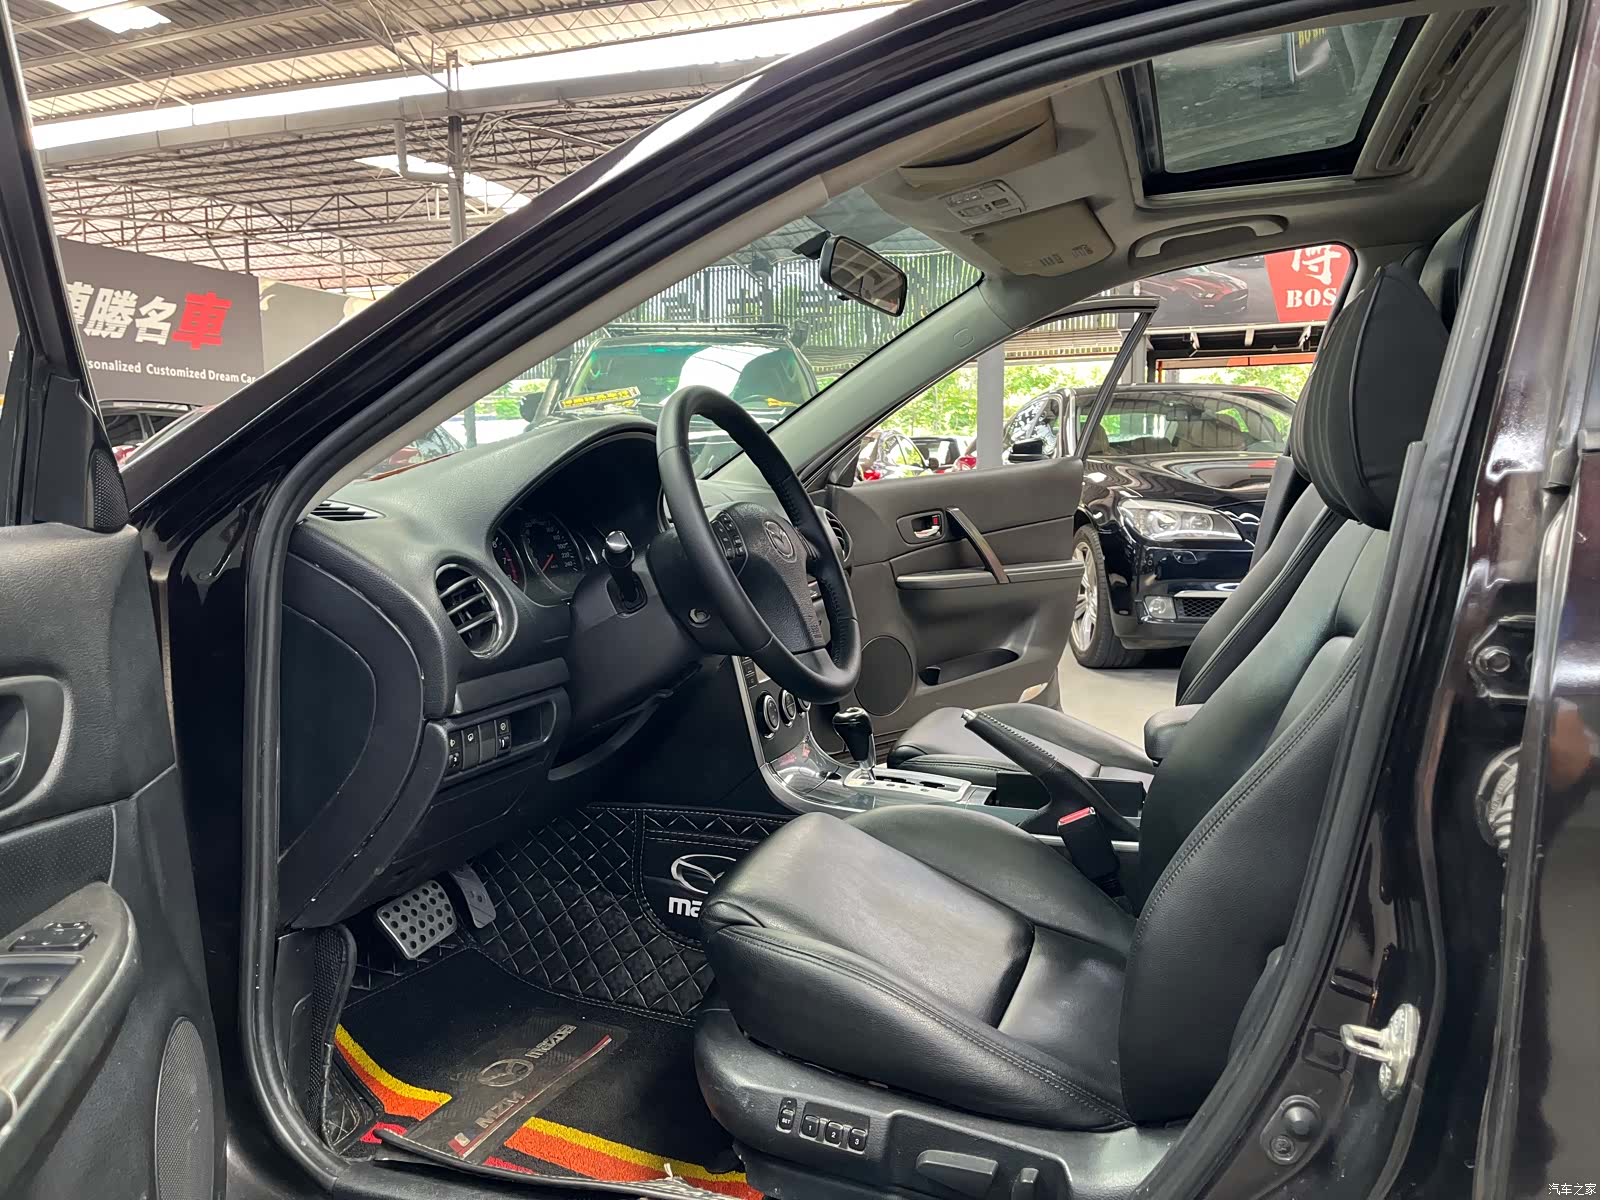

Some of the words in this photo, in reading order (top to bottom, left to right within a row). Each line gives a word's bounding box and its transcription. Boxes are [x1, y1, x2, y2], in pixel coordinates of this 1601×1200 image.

[86, 359, 142, 375] sonalized
[146, 363, 208, 381] Customized
[208, 369, 240, 384] Dream
